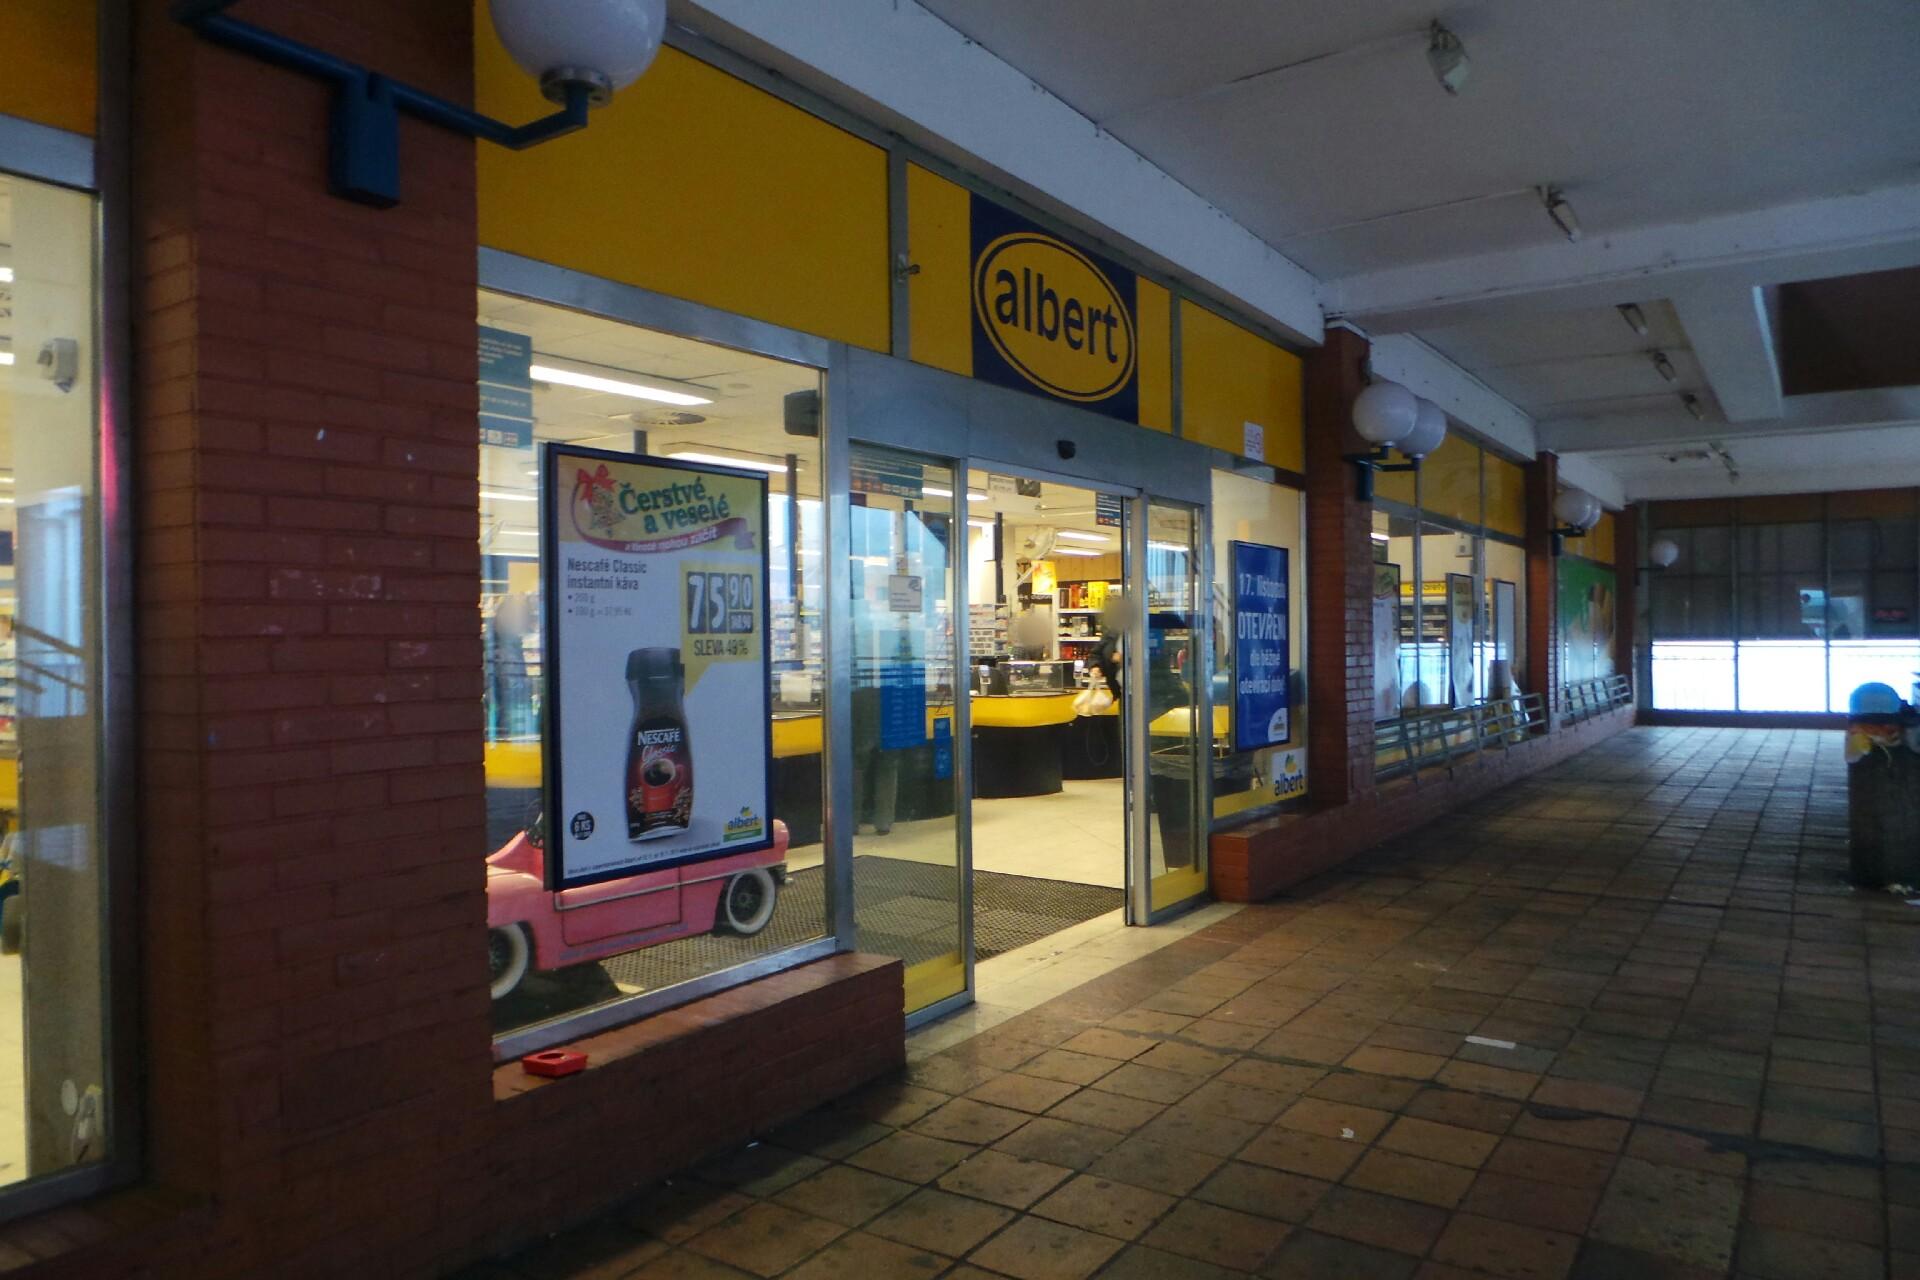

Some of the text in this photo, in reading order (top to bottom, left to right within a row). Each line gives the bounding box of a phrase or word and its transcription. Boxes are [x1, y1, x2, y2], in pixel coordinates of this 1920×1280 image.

[995, 267, 1118, 364] albert
[620, 476, 705, 514] Čerstvé
[644, 494, 730, 534] a veselé
[568, 558, 647, 574] Nescafé Classic
[568, 574, 639, 590] instantní káva
[1239, 573, 1254, 596] 17.
[688, 575, 752, 629] 75 90
[694, 639, 724, 656] SLEVA
[637, 728, 681, 746] NESCAFÉ
[1274, 769, 1304, 797] albert
[727, 813, 759, 831] albert
